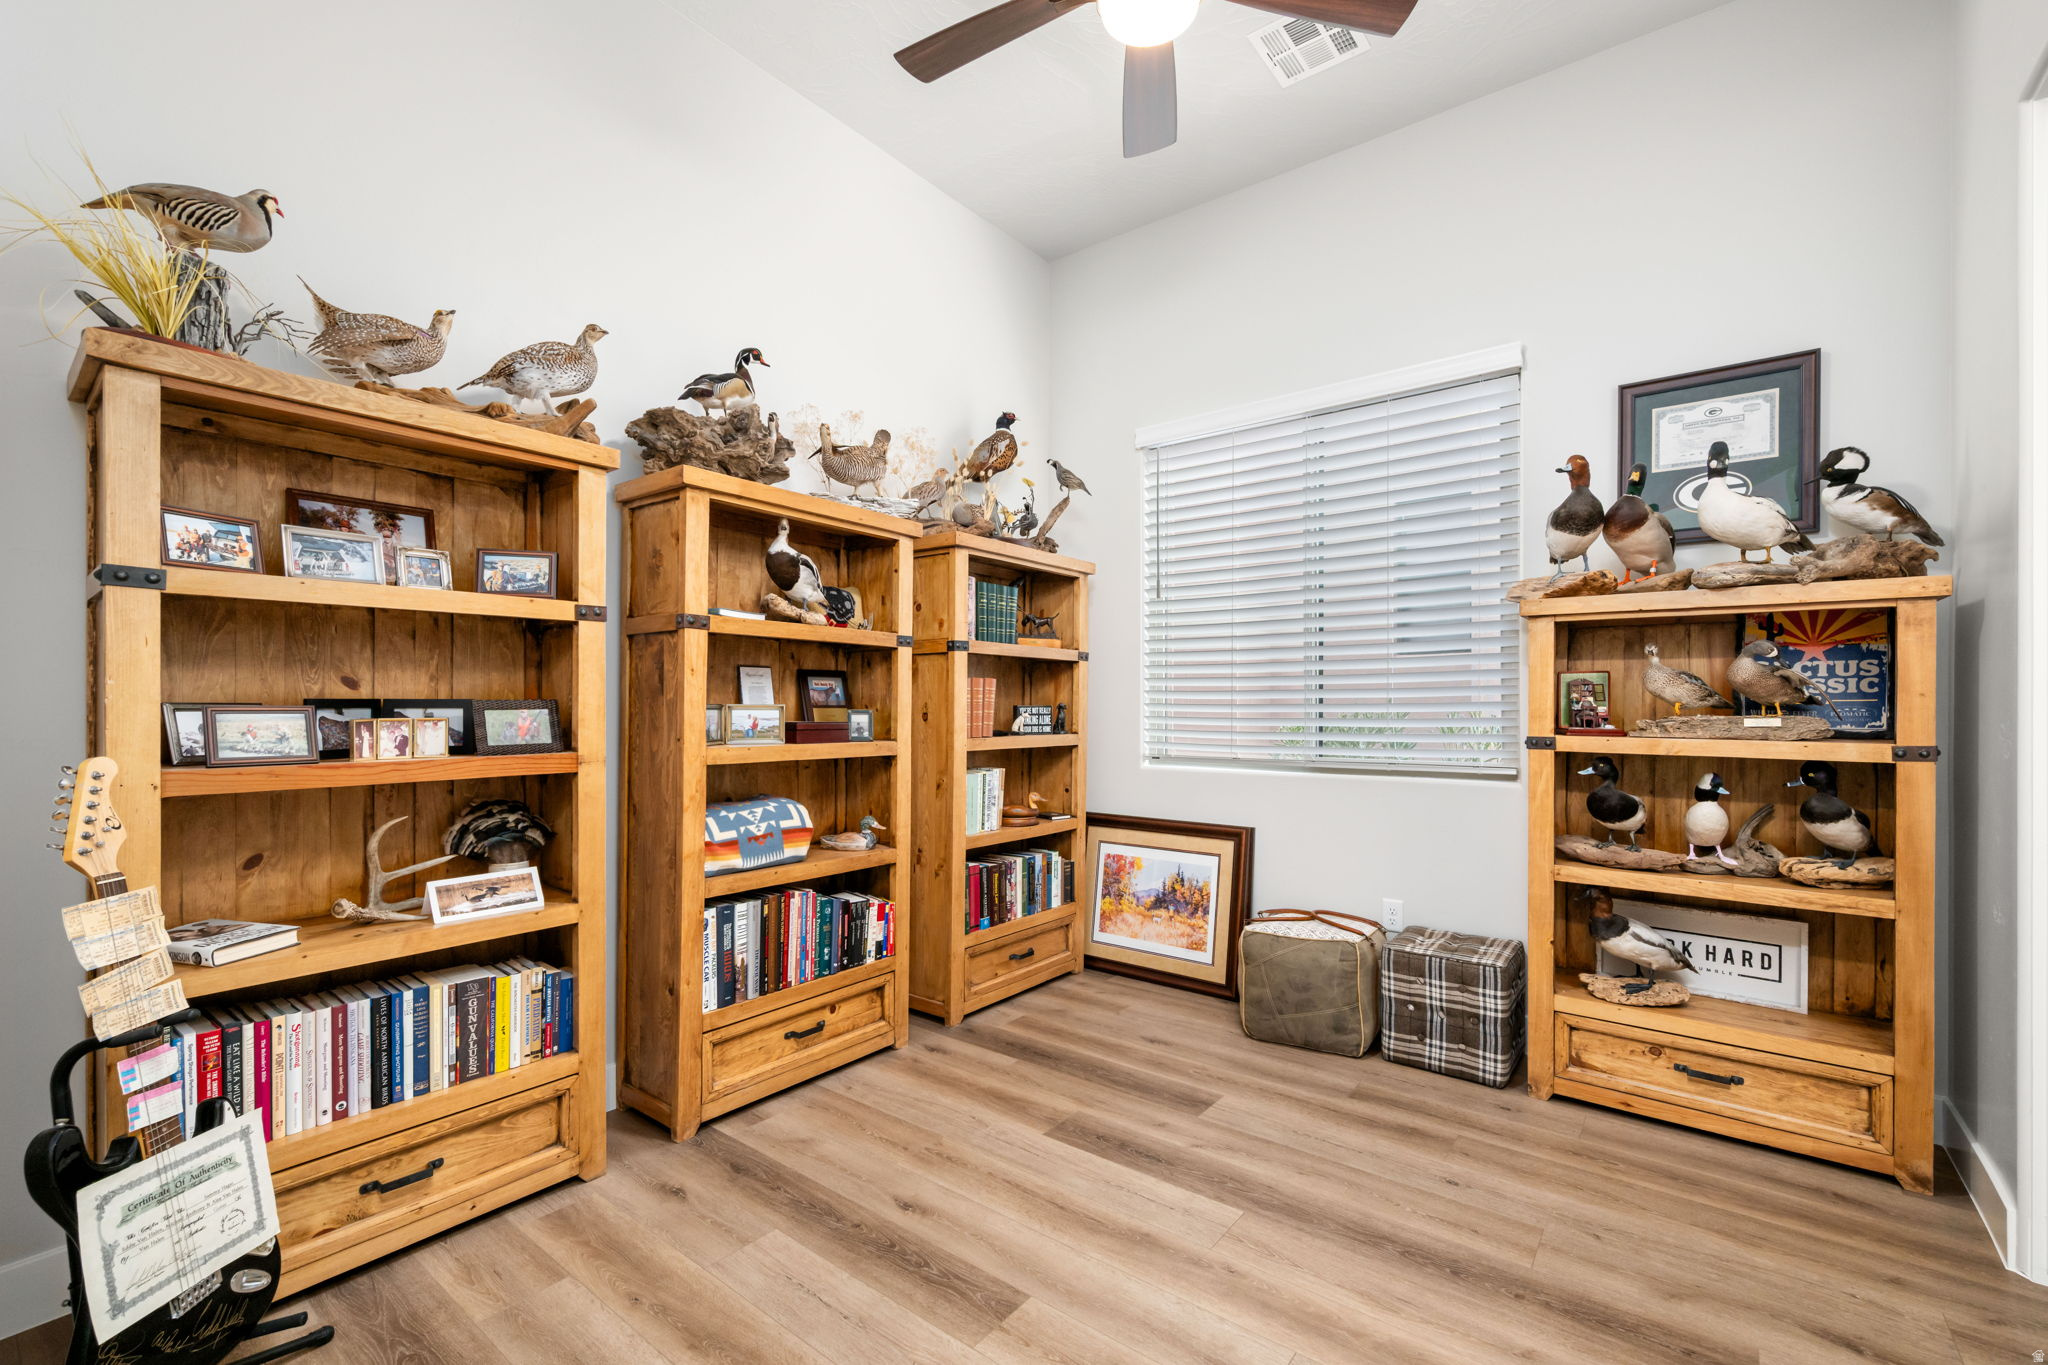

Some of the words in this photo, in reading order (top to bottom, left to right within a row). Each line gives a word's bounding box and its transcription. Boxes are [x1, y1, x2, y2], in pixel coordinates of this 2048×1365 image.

[1796, 659, 1880, 677] CTUS
[1809, 677, 1879, 693] SSIC
[1705, 944, 1772, 970] HARD
[1697, 966, 1733, 976] UMBLE
[381, 1016, 387, 1024] OF
[468, 998, 478, 1024] GUN
[533, 998, 541, 1042] PREDATORS
[292, 1023, 302, 1068] Shotgunning
[468, 1024, 479, 1073] VALUES
[127, 1186, 171, 1213] Certificate
[174, 1179, 186, 1190] Of
[189, 1156, 233, 1181] Authenticity
